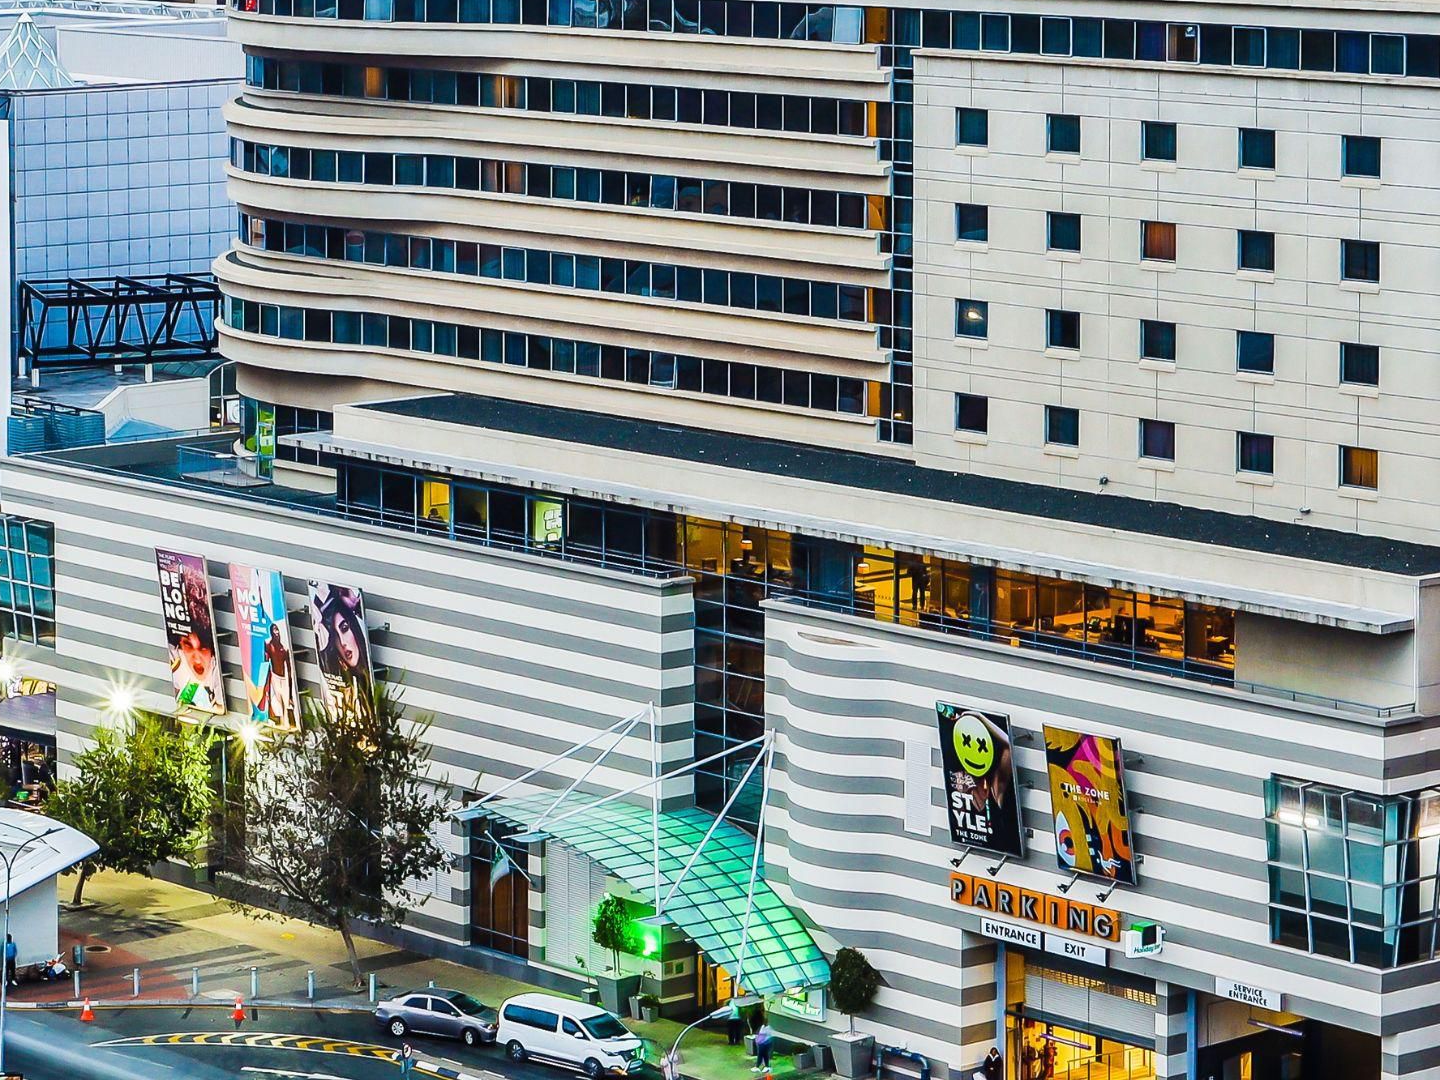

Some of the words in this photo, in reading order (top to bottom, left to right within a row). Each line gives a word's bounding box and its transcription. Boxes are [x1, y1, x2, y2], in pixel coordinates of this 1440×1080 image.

[160, 570, 180, 588] BE
[162, 586, 182, 604] LO
[236, 587, 260, 605] MO
[1063, 782, 1082, 794] THE
[1085, 786, 1109, 800] ZONE
[951, 791, 973, 811] ST
[956, 829, 968, 838] THE
[970, 832, 988, 842] ZONE
[952, 878, 1114, 938] PARKING
[985, 922, 1037, 945] ENTRANCE
[1064, 942, 1086, 958] EXIT
[1228, 990, 1268, 1006] ENTRANCE
[1233, 983, 1263, 998] SERVICE
